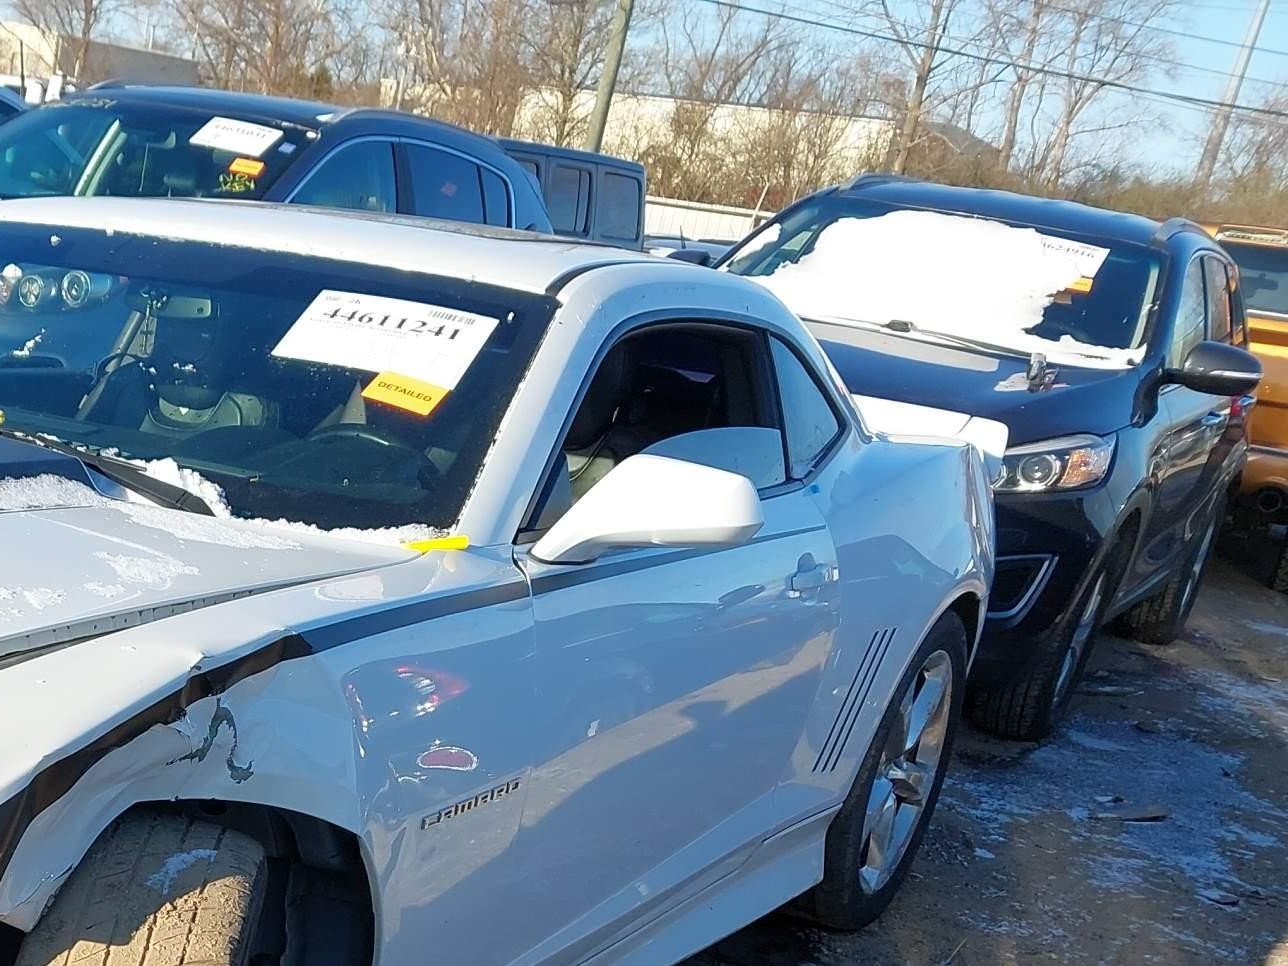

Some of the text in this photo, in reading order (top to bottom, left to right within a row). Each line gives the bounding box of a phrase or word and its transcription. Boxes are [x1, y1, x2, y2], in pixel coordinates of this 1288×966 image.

[221, 179, 256, 193] KEY
[322, 306, 462, 341] 44611241
[377, 380, 433, 403] DETAILED
[420, 776, 521, 831] CAMARO
